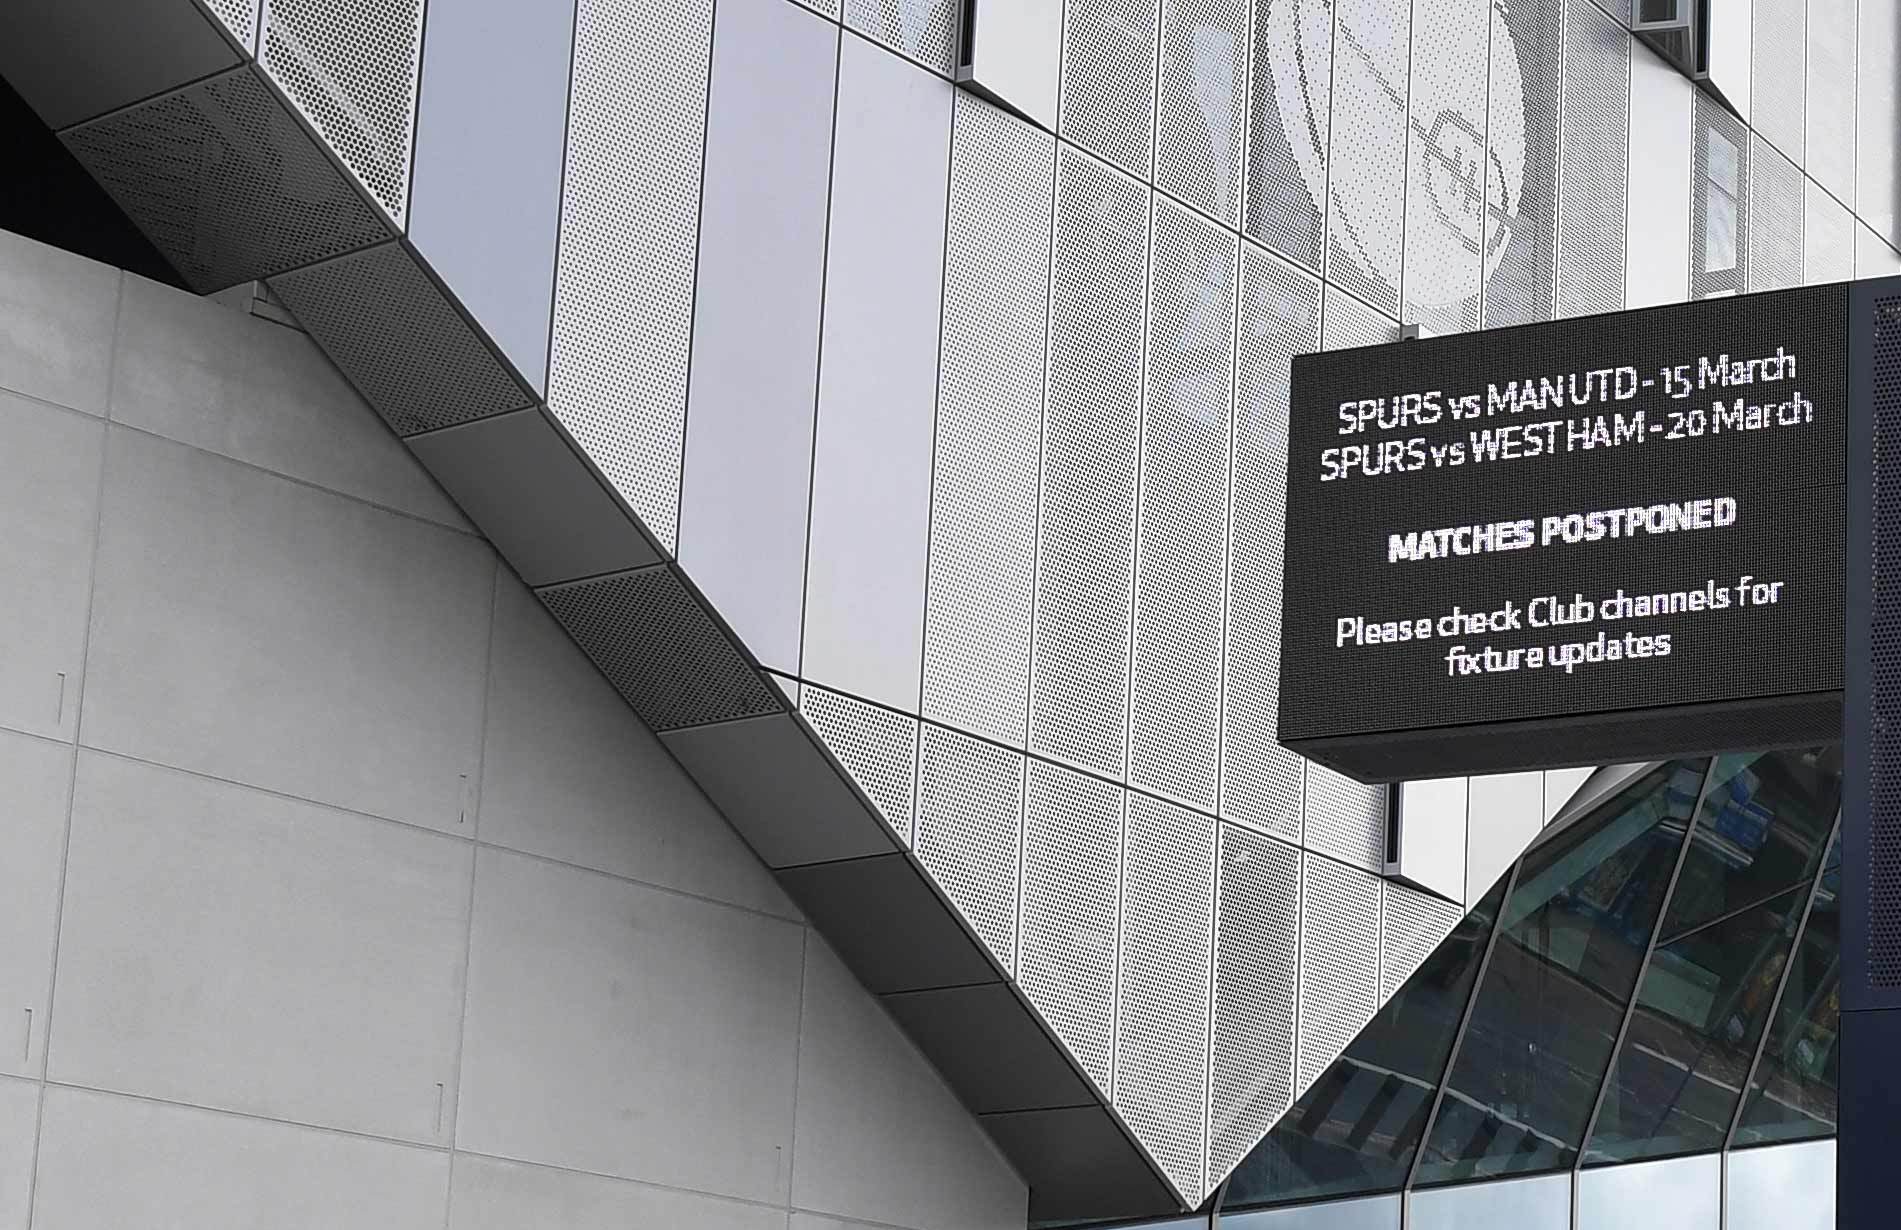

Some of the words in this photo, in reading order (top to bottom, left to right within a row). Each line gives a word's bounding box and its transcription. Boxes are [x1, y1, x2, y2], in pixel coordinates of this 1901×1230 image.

[1338, 391, 1442, 434] SPURS
[1448, 394, 1481, 421] vs
[1487, 375, 1565, 416] MAN
[1569, 367, 1638, 405] UTD
[1661, 365, 1691, 396] 15
[1698, 347, 1797, 390] March
[1320, 438, 1426, 481] SPURS
[1431, 441, 1465, 468] vs
[1470, 420, 1562, 463] WEST
[1567, 411, 1644, 452] HAM
[1667, 409, 1708, 441] 20
[1712, 391, 1813, 433] March
[1388, 518, 1534, 563] MATCHES
[1541, 496, 1736, 546] POSTPONED
[1336, 614, 1432, 647] Please
[1437, 602, 1521, 637] check
[1528, 594, 1594, 628] Club
[1600, 579, 1730, 621] channels
[1734, 575, 1784, 608] for
[1443, 640, 1543, 676] fixture
[1549, 630, 1671, 673] updates
